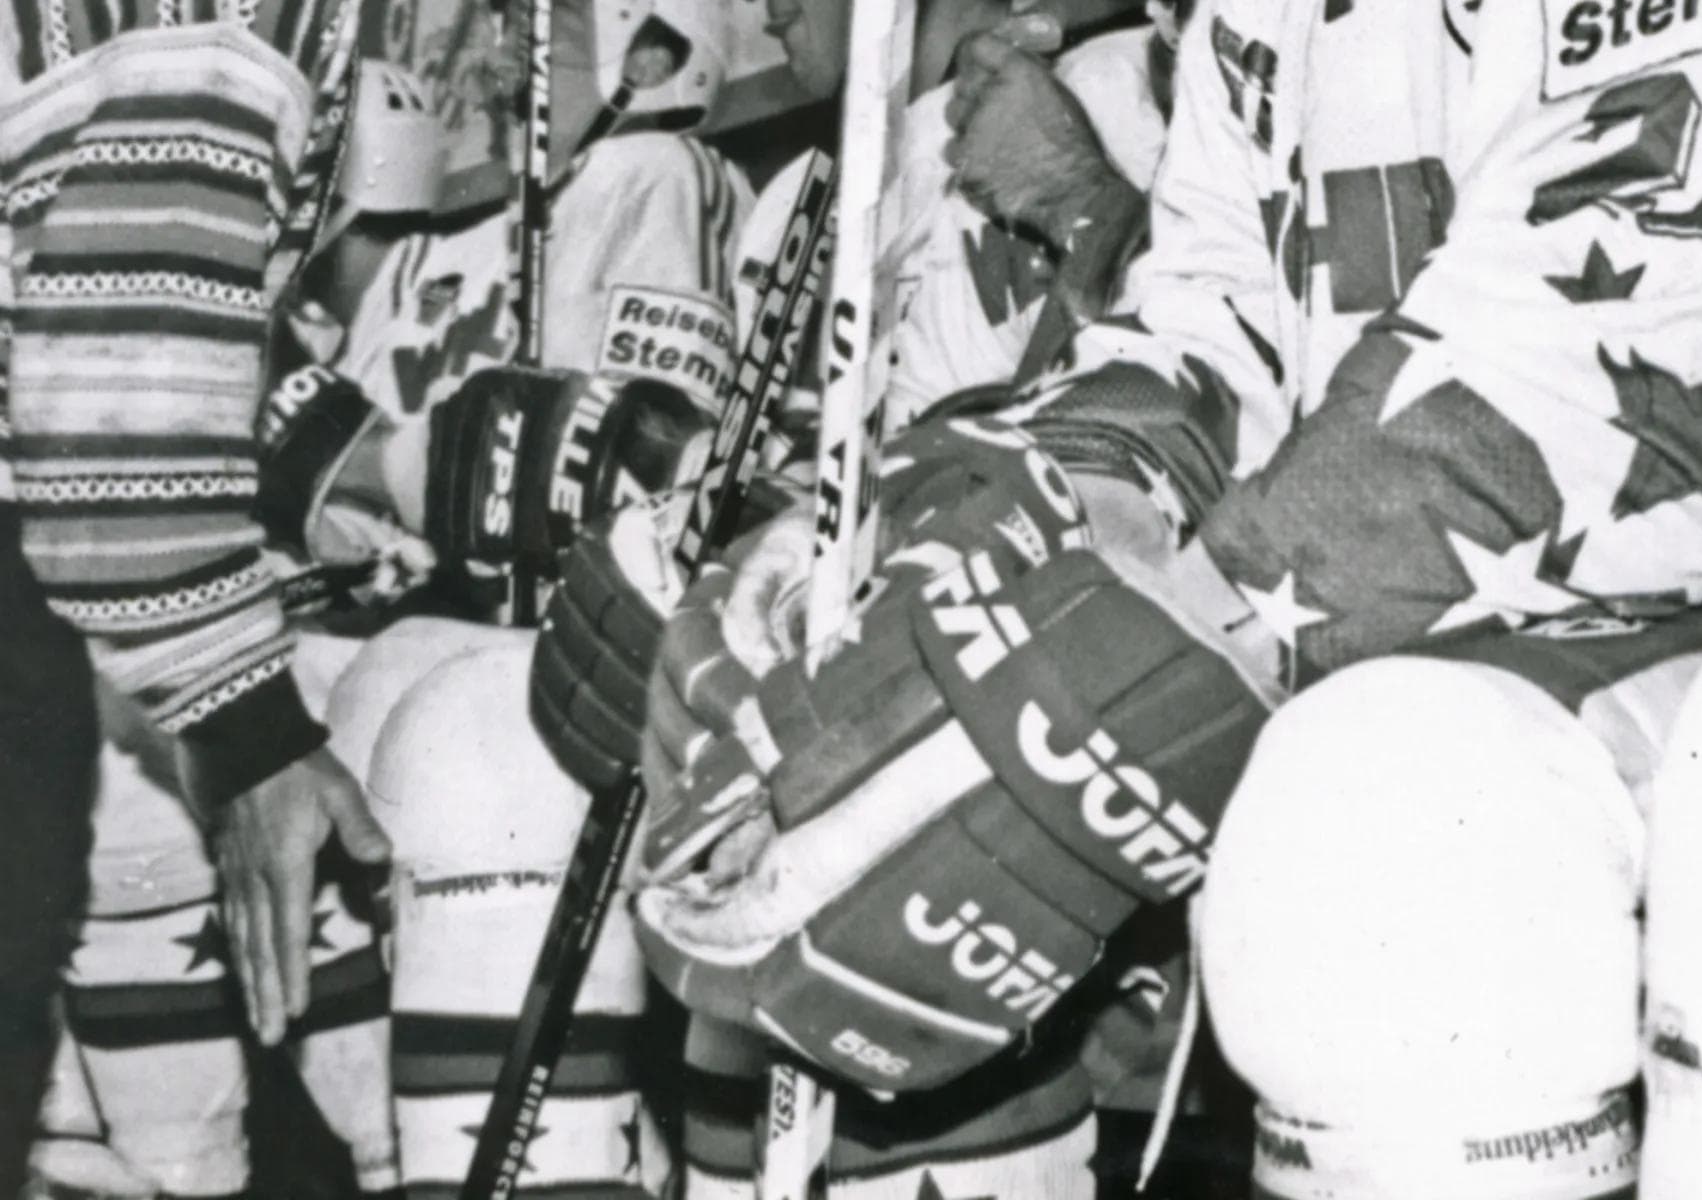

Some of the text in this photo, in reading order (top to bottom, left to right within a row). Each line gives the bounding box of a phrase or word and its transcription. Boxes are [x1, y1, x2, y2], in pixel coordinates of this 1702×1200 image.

[619, 297, 731, 349] Reiseb
[485, 410, 524, 536] TPS
[552, 377, 617, 522] VILLE
[1017, 700, 1208, 896] JOFA
[903, 893, 1075, 1022] JOFA
